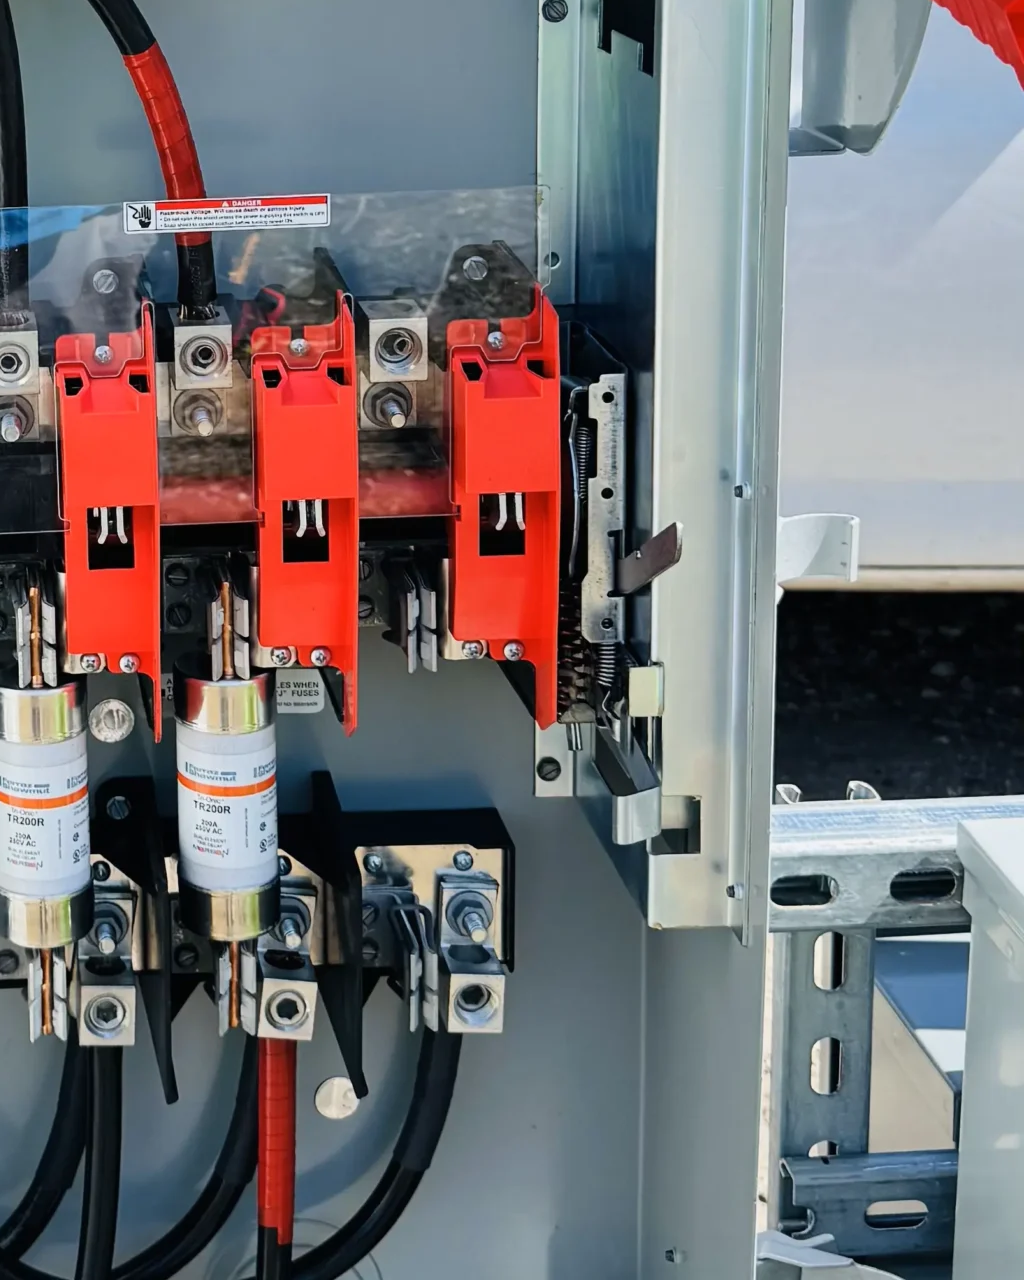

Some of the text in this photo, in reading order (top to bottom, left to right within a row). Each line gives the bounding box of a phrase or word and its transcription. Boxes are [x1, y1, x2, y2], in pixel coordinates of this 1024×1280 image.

[193, 800, 231, 814] TR200R
[6, 813, 44, 826] TR200R
[201, 818, 218, 828] 200A
[15, 832, 32, 840] 200A
[26, 840, 36, 848] AC
